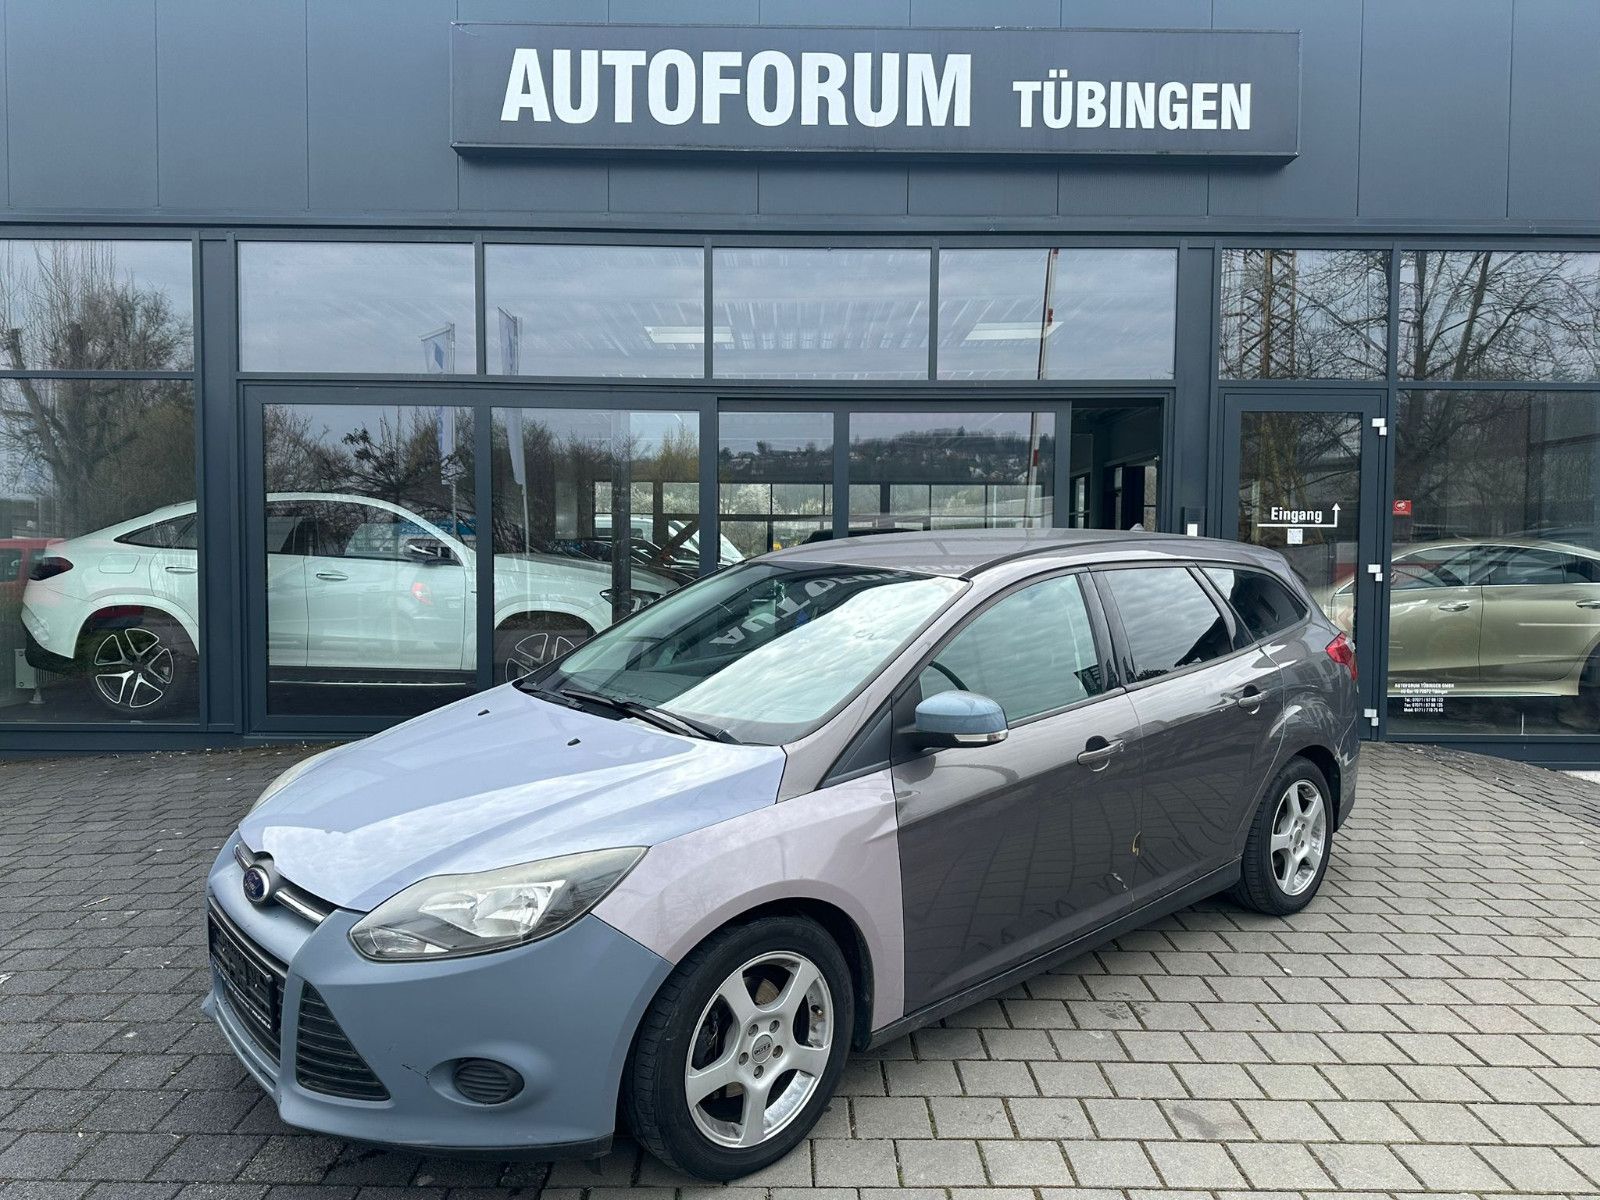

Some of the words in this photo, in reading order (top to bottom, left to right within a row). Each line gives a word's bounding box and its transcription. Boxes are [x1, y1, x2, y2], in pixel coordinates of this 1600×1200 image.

[501, 48, 971, 127] AUTOFORUM
[1013, 69, 1251, 130] TÜBINGEN
[1271, 507, 1322, 523] Eingang
